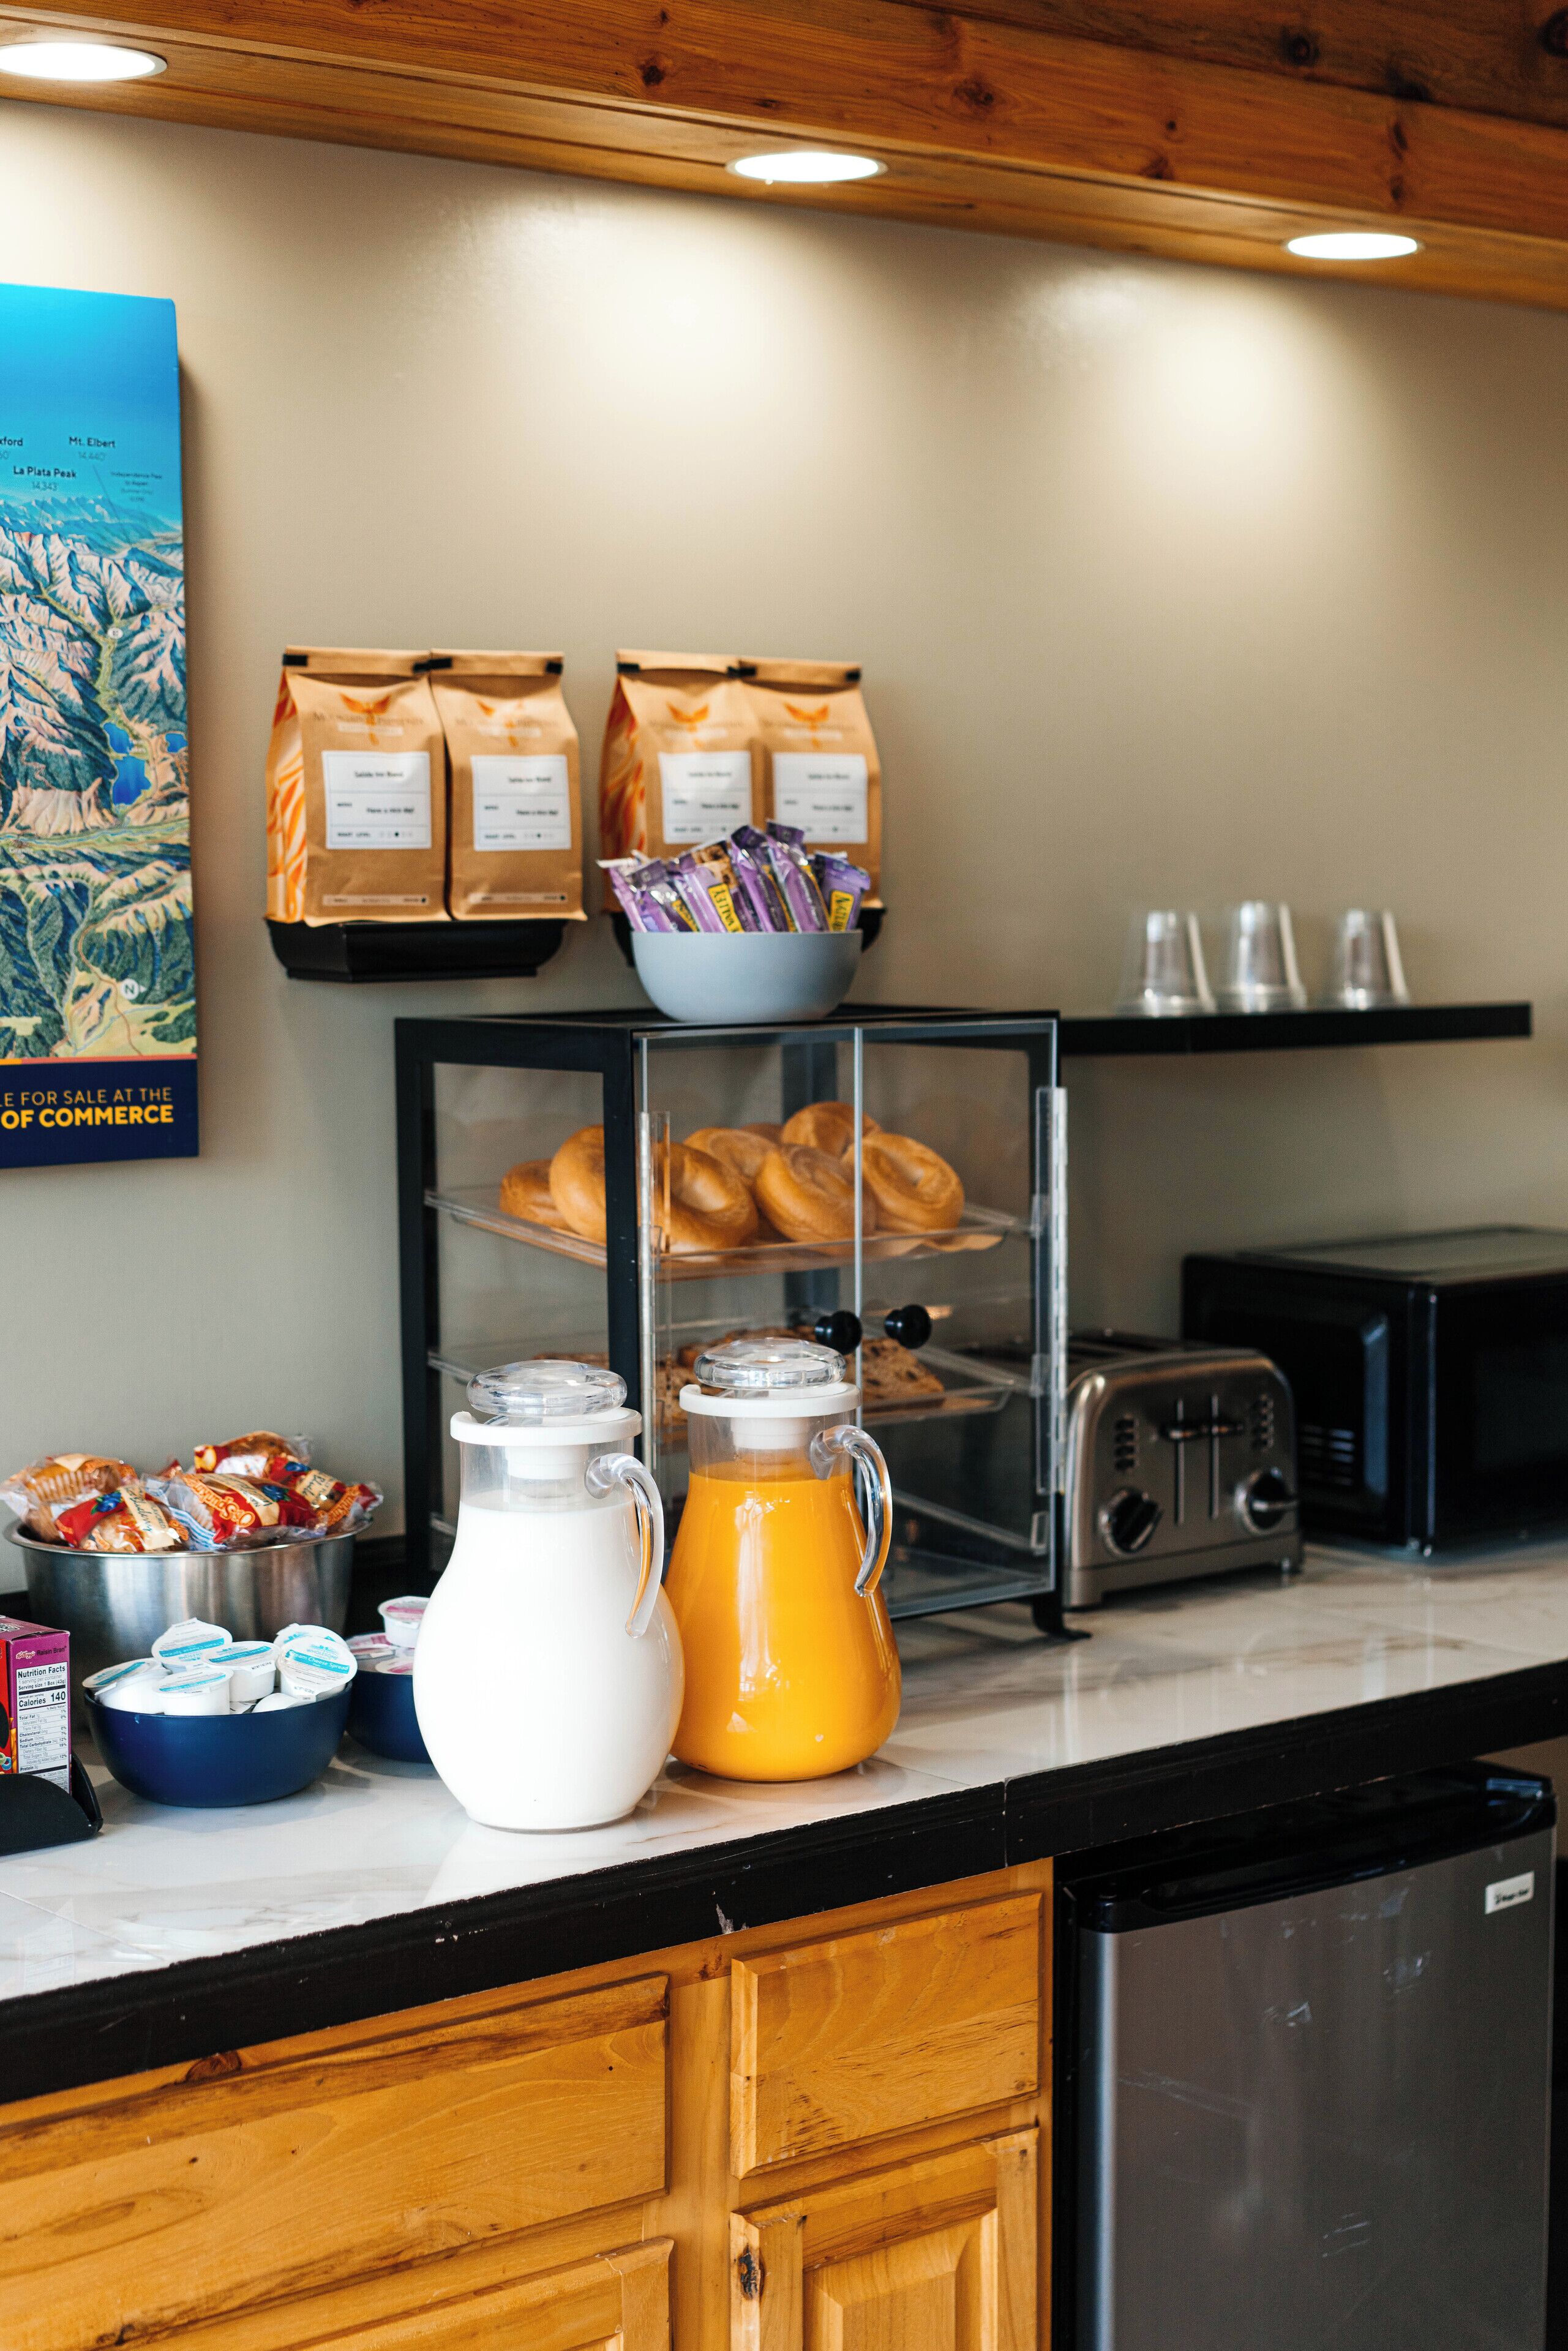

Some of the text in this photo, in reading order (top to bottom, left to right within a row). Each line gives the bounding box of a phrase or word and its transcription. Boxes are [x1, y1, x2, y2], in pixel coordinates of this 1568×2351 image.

[0, 437, 23, 446] xford
[69, 437, 115, 448] Mt. Elbert
[13, 466, 77, 478] La Plata Peak
[21, 1091, 58, 1106] FOR
[63, 1089, 107, 1105] SALE
[113, 1088, 133, 1103] AT
[140, 1087, 173, 1102] THE
[1, 1104, 174, 1130] OF COMMERCE
[309, 1657, 328, 1666] Cheese
[329, 1662, 349, 1671] Spread
[18, 1669, 47, 1678] Nutrition
[19, 1691, 66, 1708] Calories 140
